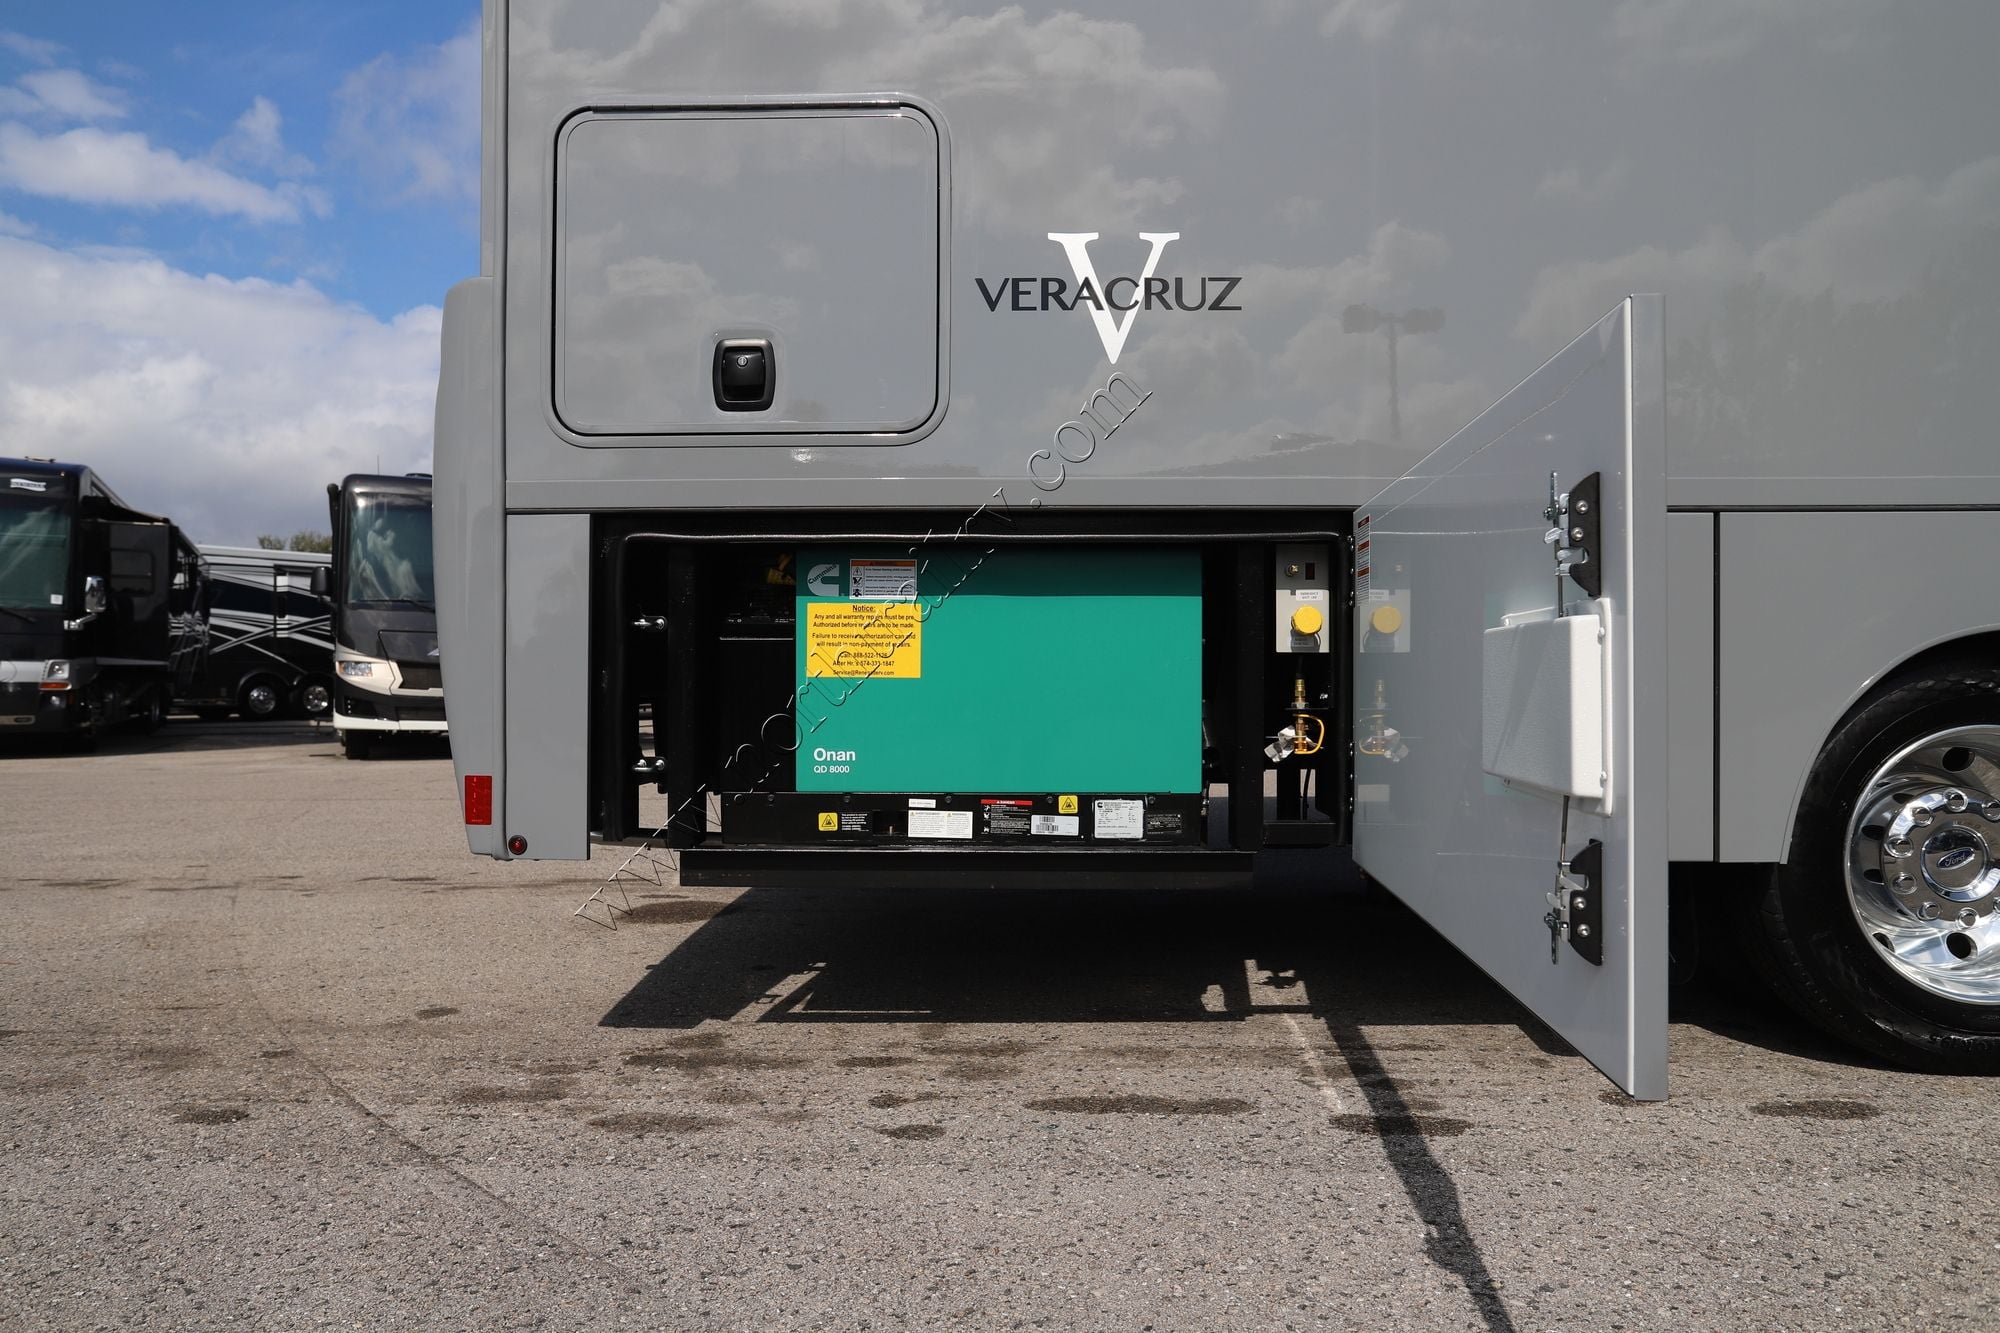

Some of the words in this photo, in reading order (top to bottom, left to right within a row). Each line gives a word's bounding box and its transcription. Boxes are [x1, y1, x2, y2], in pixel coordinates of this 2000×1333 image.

[974, 276, 1242, 312] VERACRUZ
[1047, 232, 1180, 364] V
[808, 562, 837, 584] Cummins
[852, 604, 876, 613] Notice:
[849, 641, 885, 649] non-payment
[813, 747, 856, 761] Onan
[813, 765, 828, 773] QD
[829, 765, 850, 773] 8000
[1944, 852, 1966, 867] Ford
